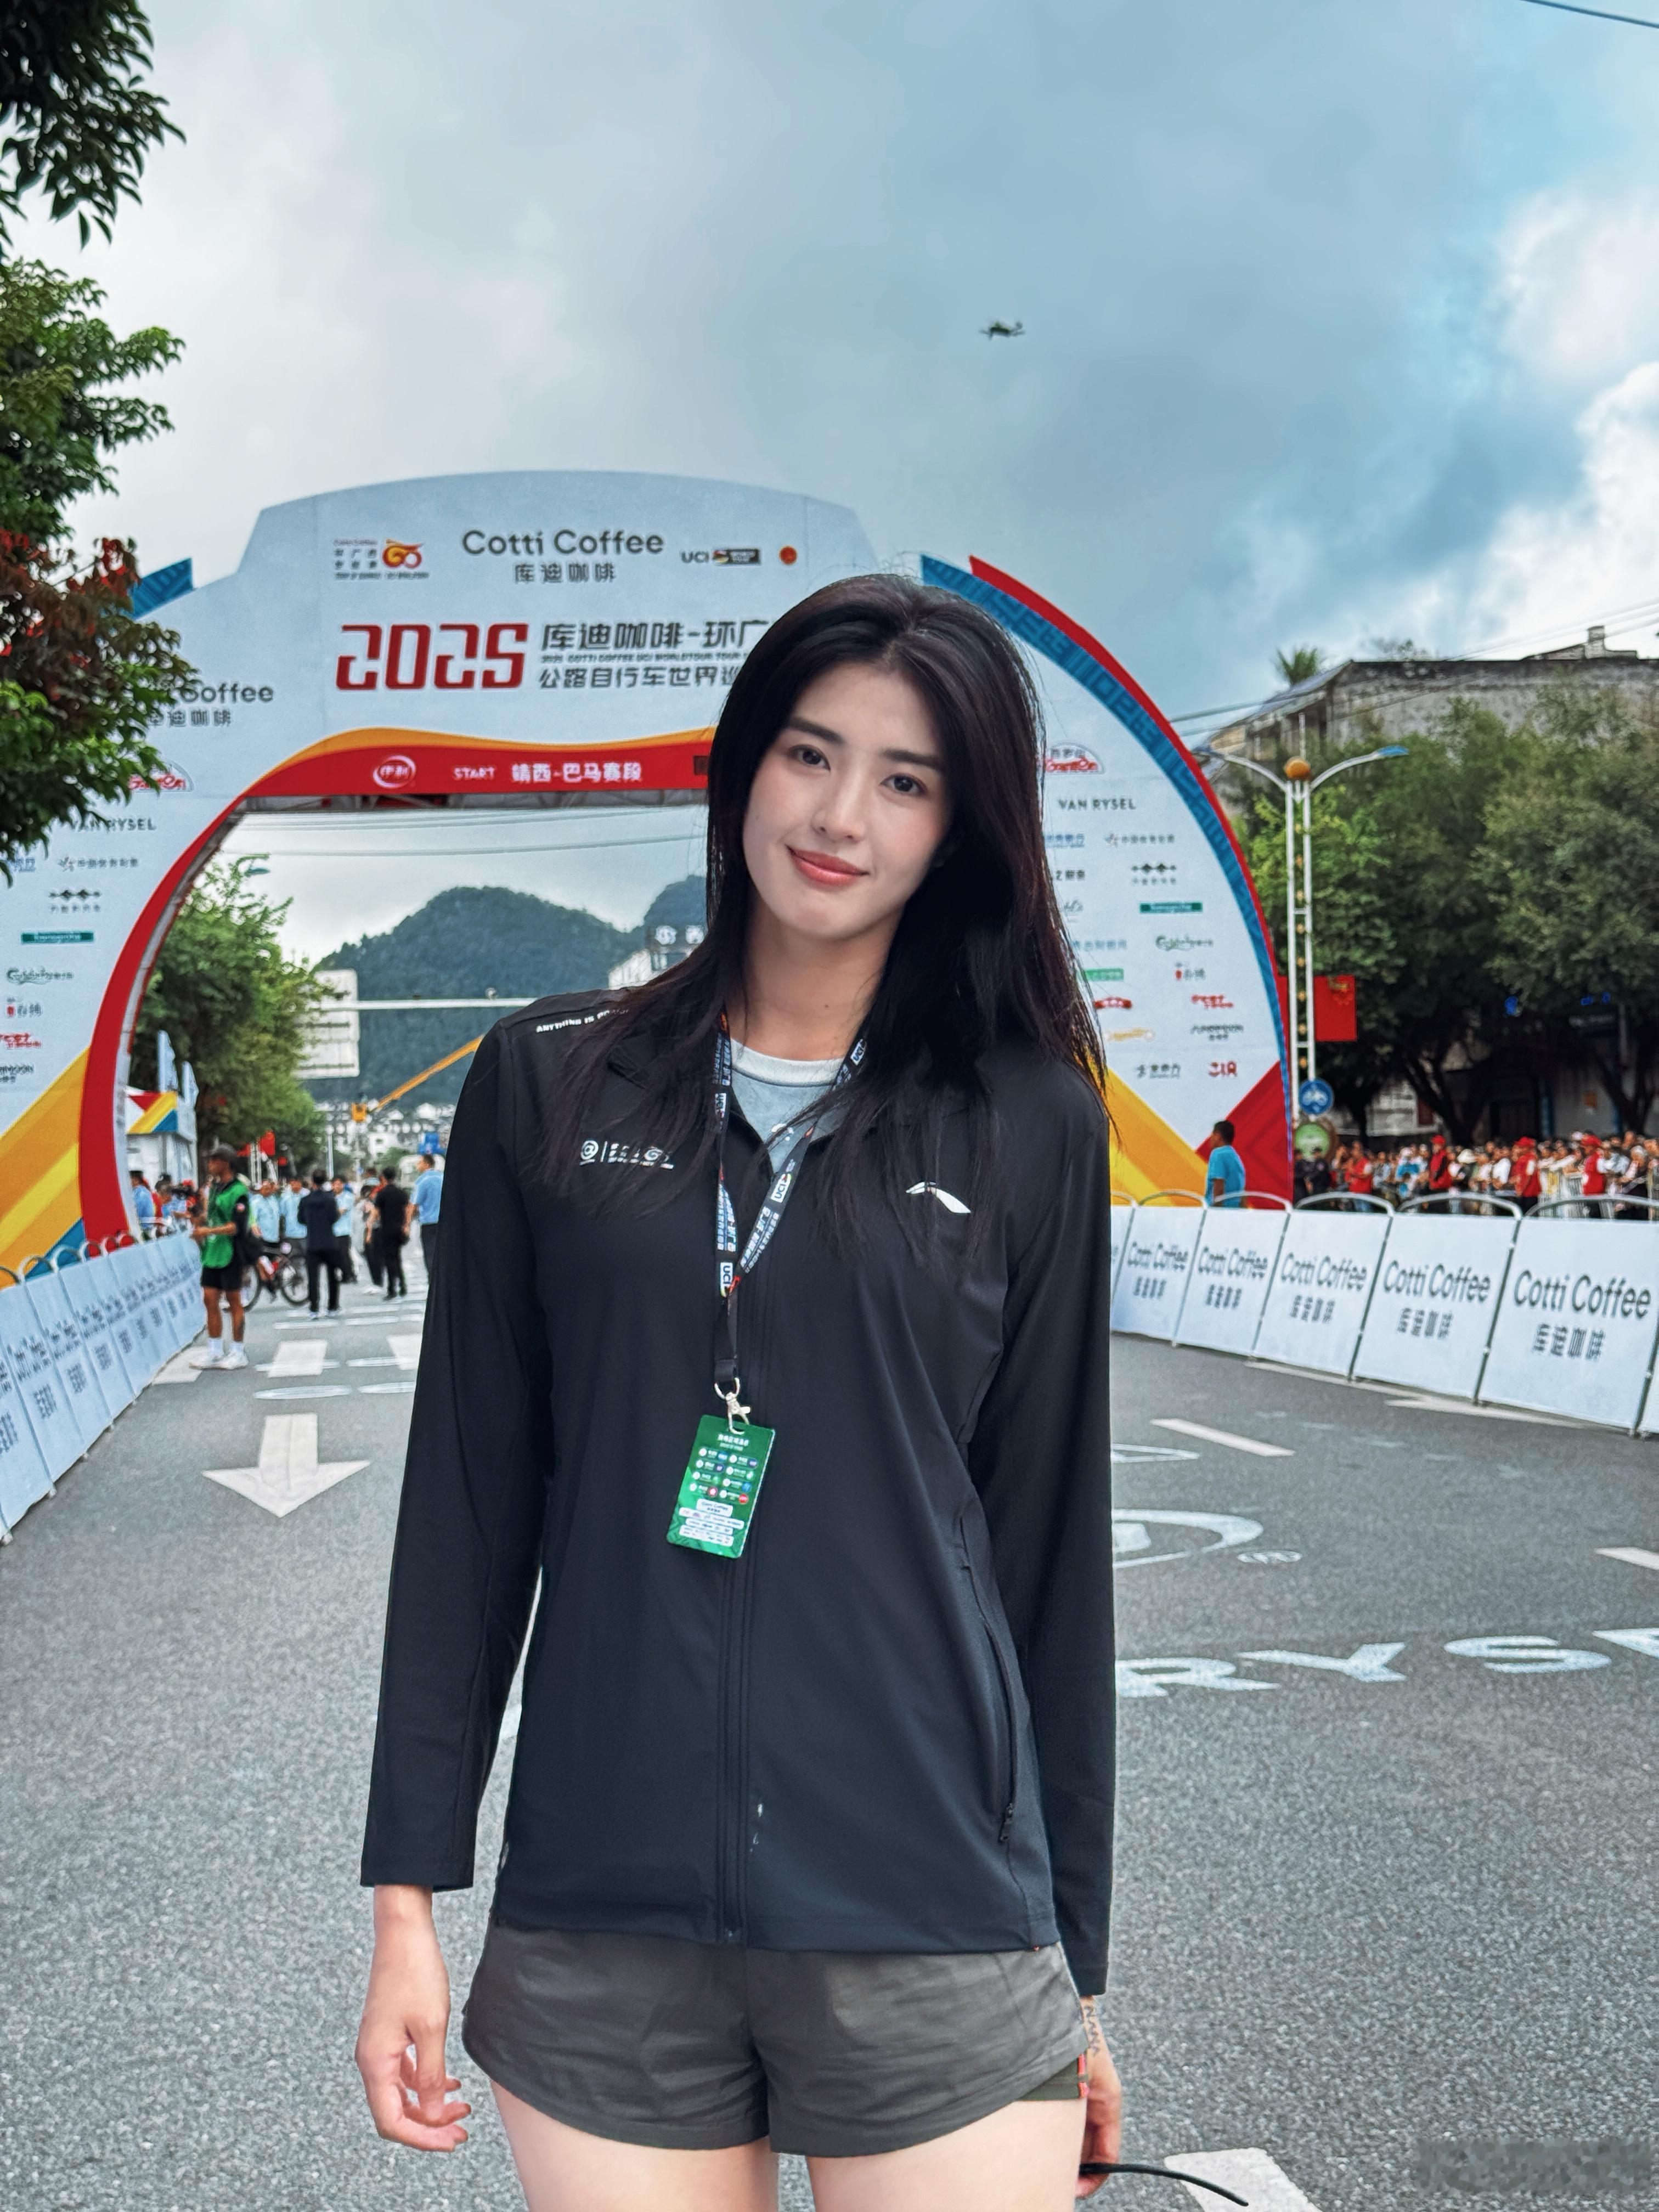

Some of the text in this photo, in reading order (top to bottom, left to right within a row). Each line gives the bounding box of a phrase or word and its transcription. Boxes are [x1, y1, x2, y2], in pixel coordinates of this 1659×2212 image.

[462, 529, 666, 556] Cotti Coffee
[681, 551, 709, 563] UCI
[514, 562, 617, 584] 库迪咖啡
[336, 624, 529, 691] 2025
[453, 767, 495, 780] START
[1058, 799, 1137, 810] VAN RYSEL
[774, 1183, 786, 1199] UCI
[723, 1265, 731, 1285] UCI
[1281, 1252, 1368, 1292] Cotti Coffee
[1383, 1260, 1491, 1304] Cotti Coffee
[1514, 1269, 1652, 1320] Cotti Coffee
